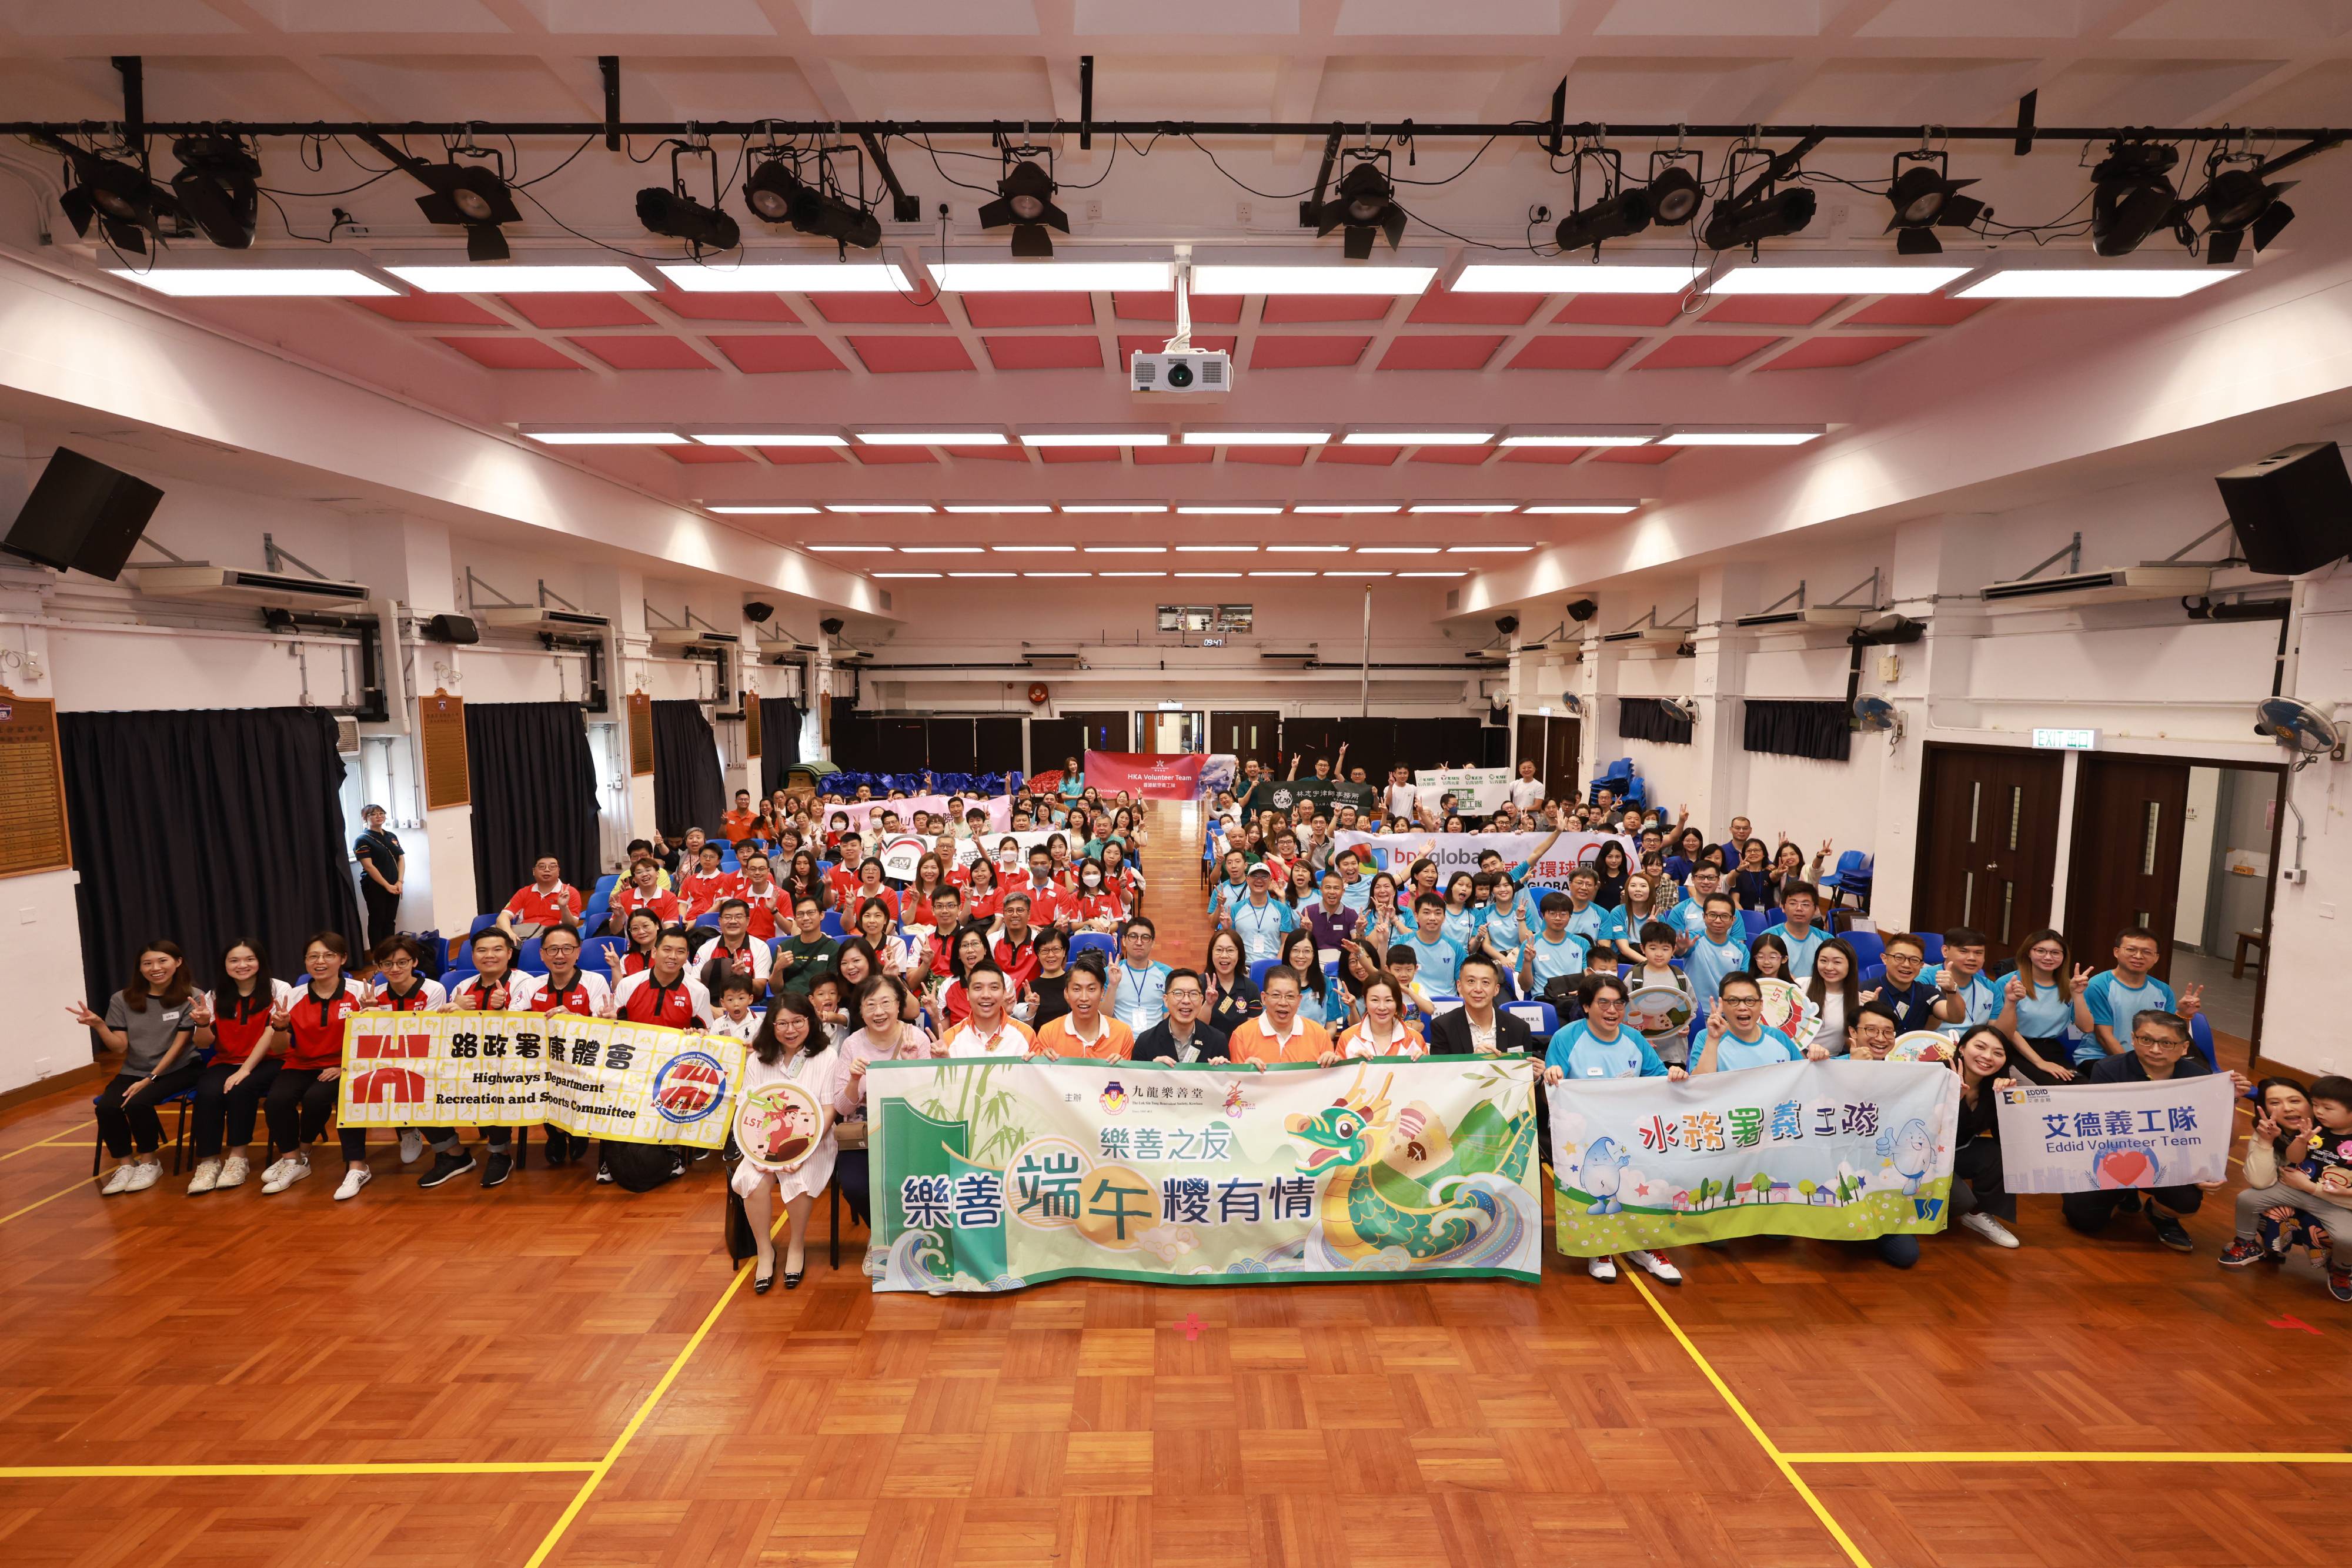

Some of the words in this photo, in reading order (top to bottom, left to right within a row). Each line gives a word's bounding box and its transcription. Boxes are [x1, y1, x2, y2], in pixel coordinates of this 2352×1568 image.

[2039, 731, 2063, 746] EXIT
[2067, 731, 2088, 747] 出口
[1770, 987, 1783, 1002] LST
[451, 1032, 636, 1069] 路政署康體會
[673, 1054, 696, 1063] Highways
[696, 1054, 719, 1069] Department
[473, 1072, 540, 1085] Highways
[544, 1072, 604, 1093] Department
[1065, 1093, 1082, 1102] 主辦
[1132, 1085, 1204, 1099] 九龍樂善堂
[436, 1094, 505, 1104] Recreation
[508, 1092, 536, 1104] and
[540, 1091, 569, 1108] Sports
[571, 1101, 636, 1119] Committee
[743, 1116, 763, 1129] LST
[1639, 1099, 1879, 1153] 水務署義工隊
[2042, 1106, 2198, 1139] 艾德義工隊
[1101, 1128, 1230, 1159] 樂善之友
[2046, 1142, 2084, 1153] Eddid
[2087, 1138, 2157, 1149] Volunteer
[2160, 1135, 2201, 1146] Team
